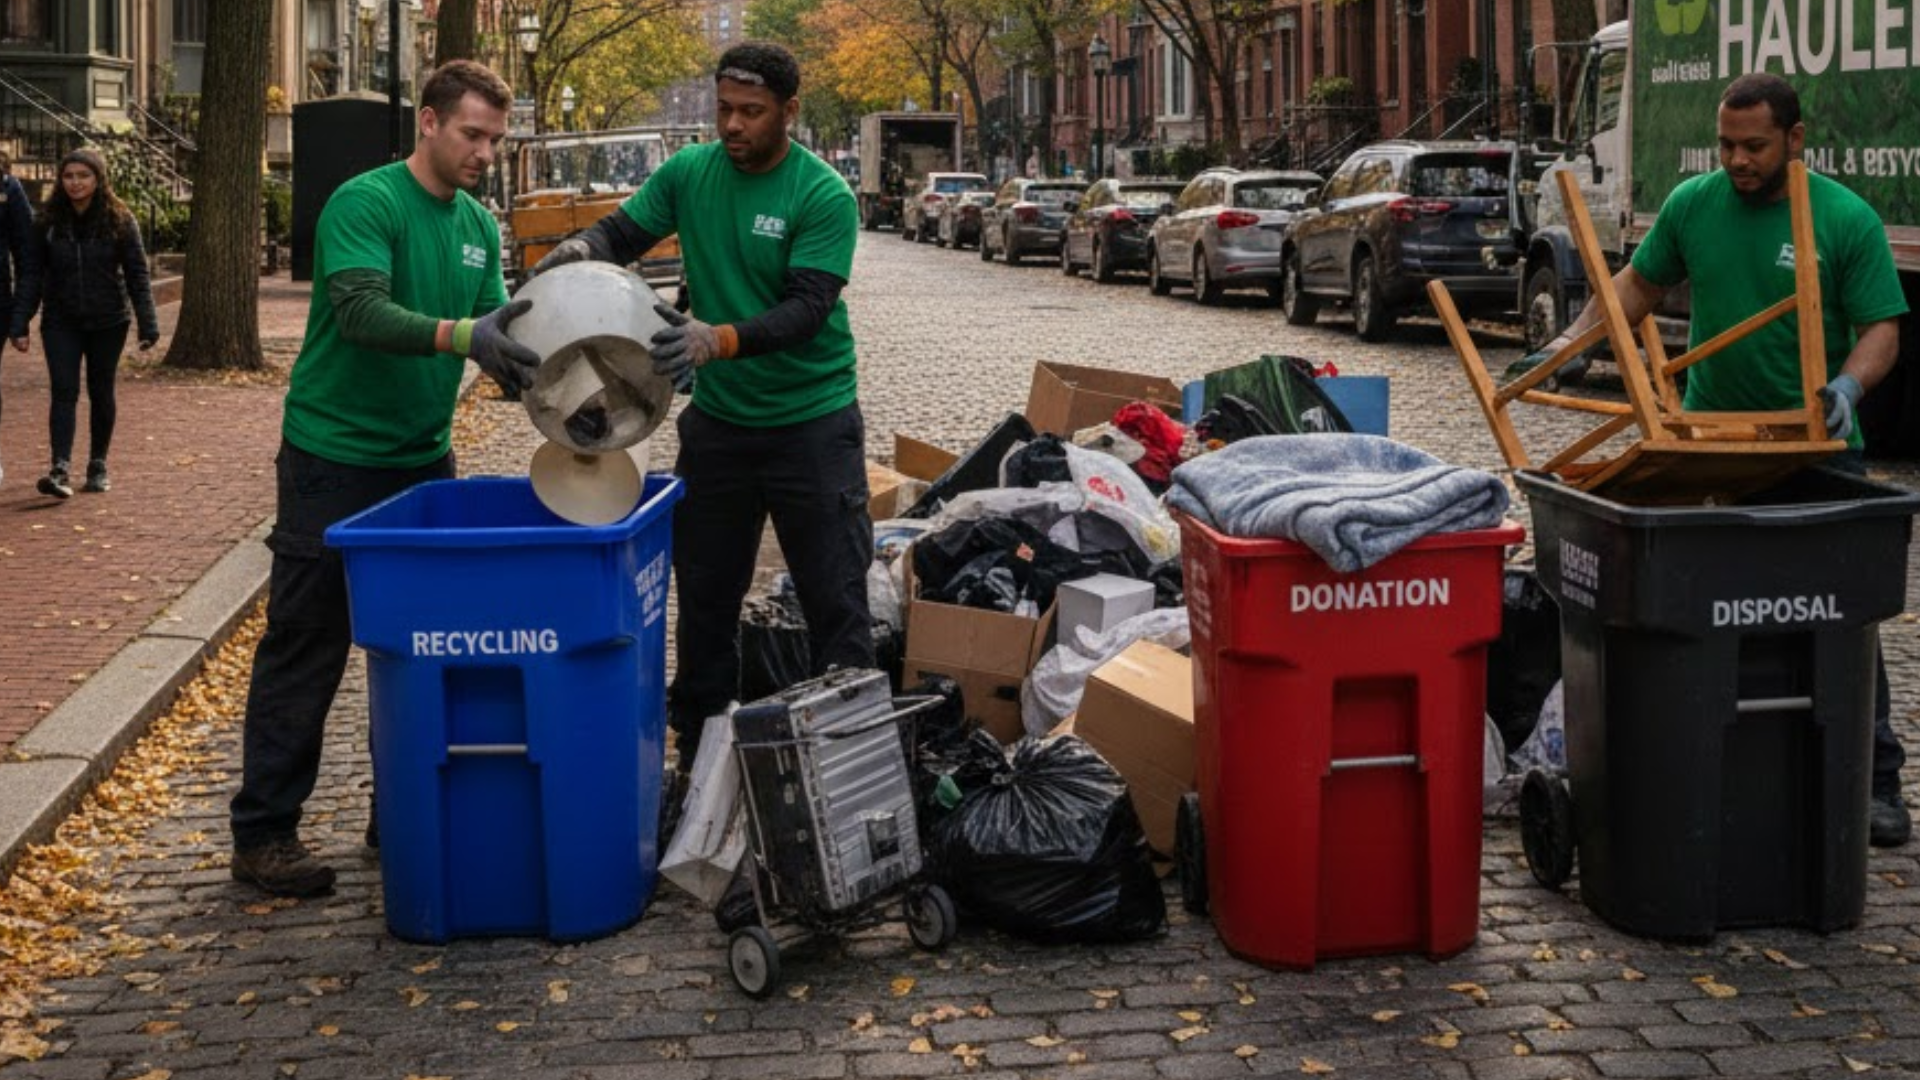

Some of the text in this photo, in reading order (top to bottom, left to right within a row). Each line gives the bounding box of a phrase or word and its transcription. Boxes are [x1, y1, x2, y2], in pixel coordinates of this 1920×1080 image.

[1718, 0, 1920, 78] HAULE
[1290, 578, 1449, 612] DONATION
[1712, 595, 1843, 626] DISPOSAL
[412, 629, 559, 656] RECYCLING
